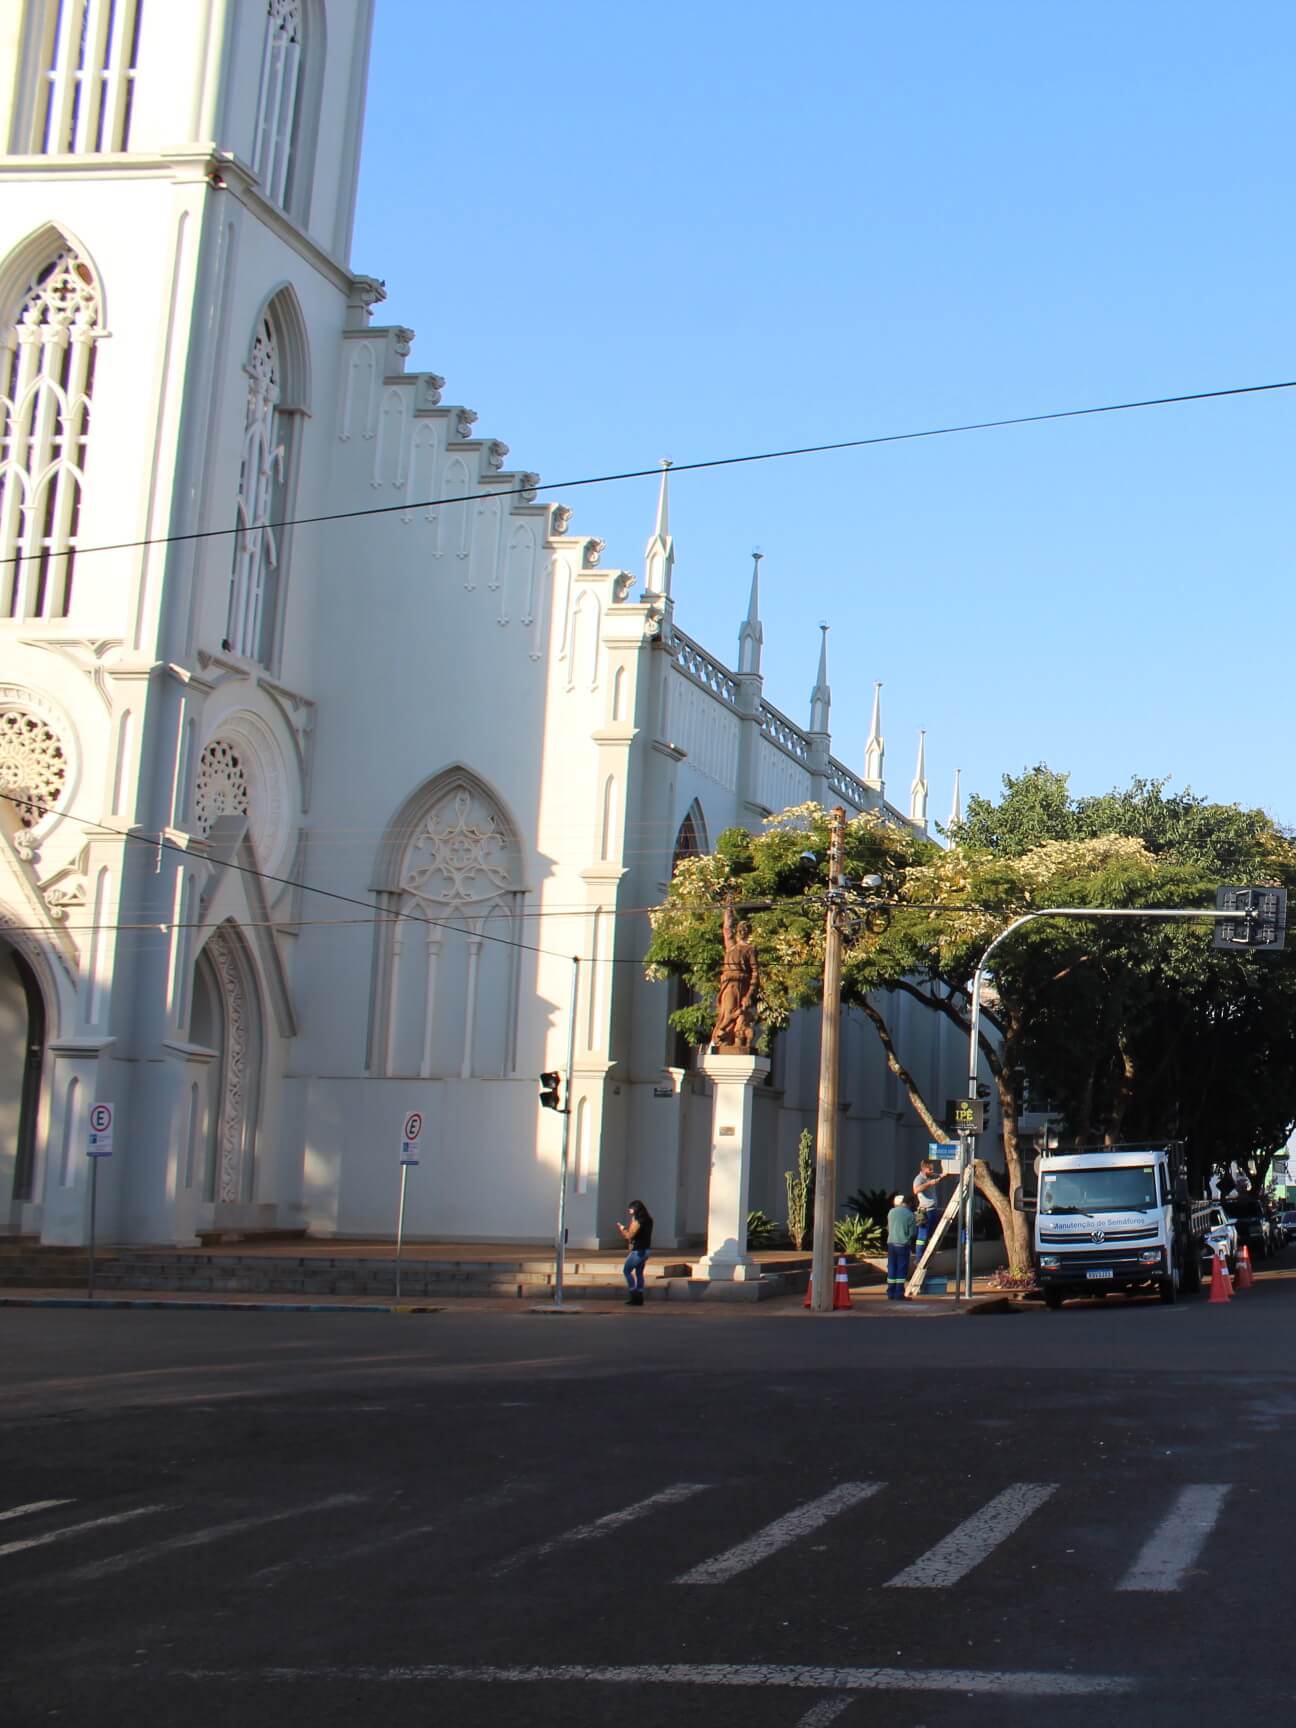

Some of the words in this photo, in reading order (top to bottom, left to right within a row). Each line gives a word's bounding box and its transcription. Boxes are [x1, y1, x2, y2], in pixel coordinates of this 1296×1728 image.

[96, 1110, 105, 1126] E
[409, 1119, 418, 1134] E
[1097, 1219, 1107, 1227] de
